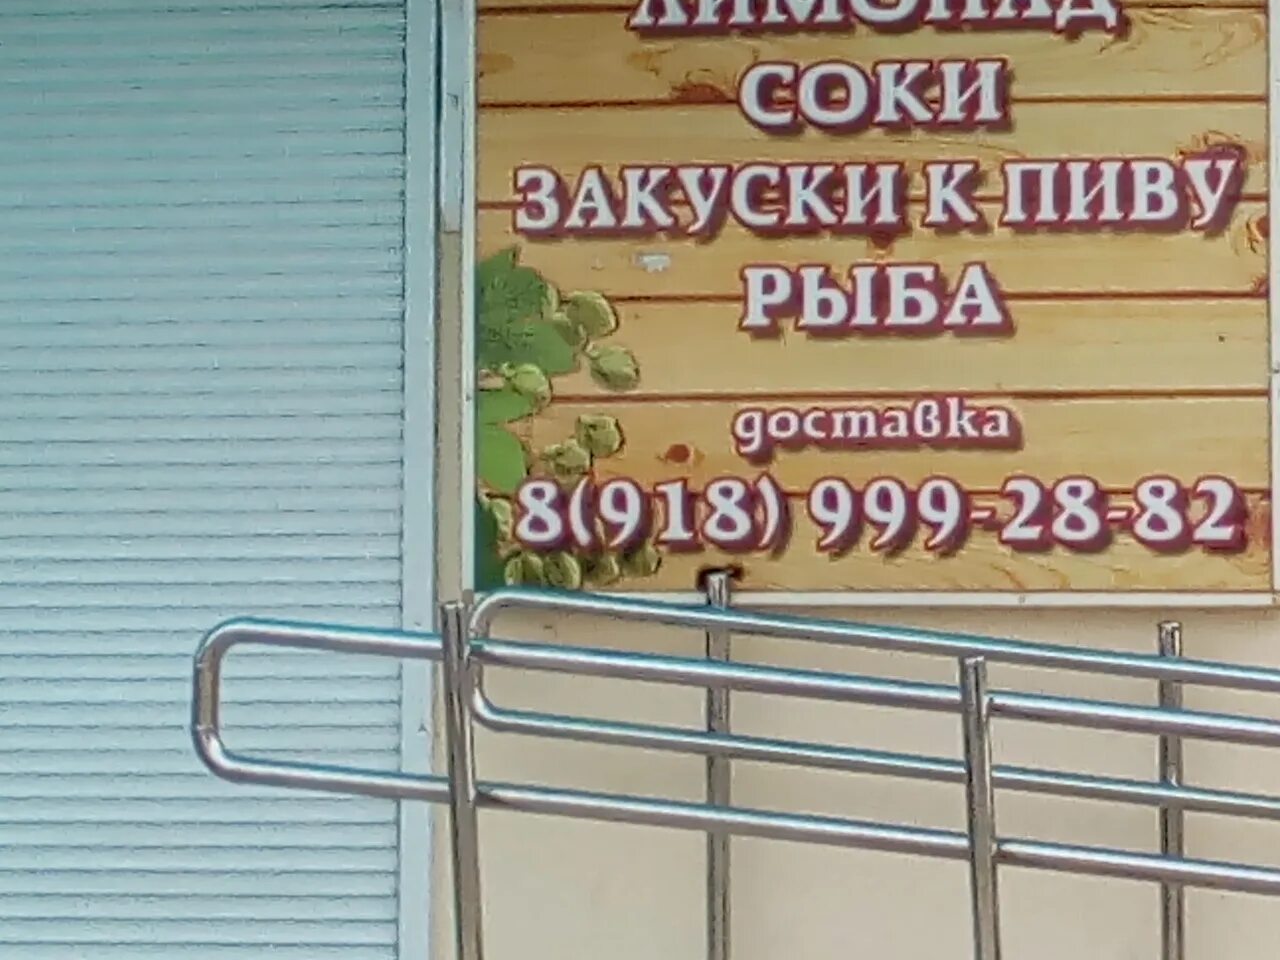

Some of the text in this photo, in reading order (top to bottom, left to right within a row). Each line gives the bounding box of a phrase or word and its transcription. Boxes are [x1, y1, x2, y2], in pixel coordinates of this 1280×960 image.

[739, 59, 1004, 126] СОКИ
[514, 156, 1238, 232] ЗАКУСКИ К ПИВУ
[741, 262, 1004, 329] РЫБА
[733, 398, 1012, 452] доставка
[515, 476, 1237, 548] 8(918) 999-28-82
